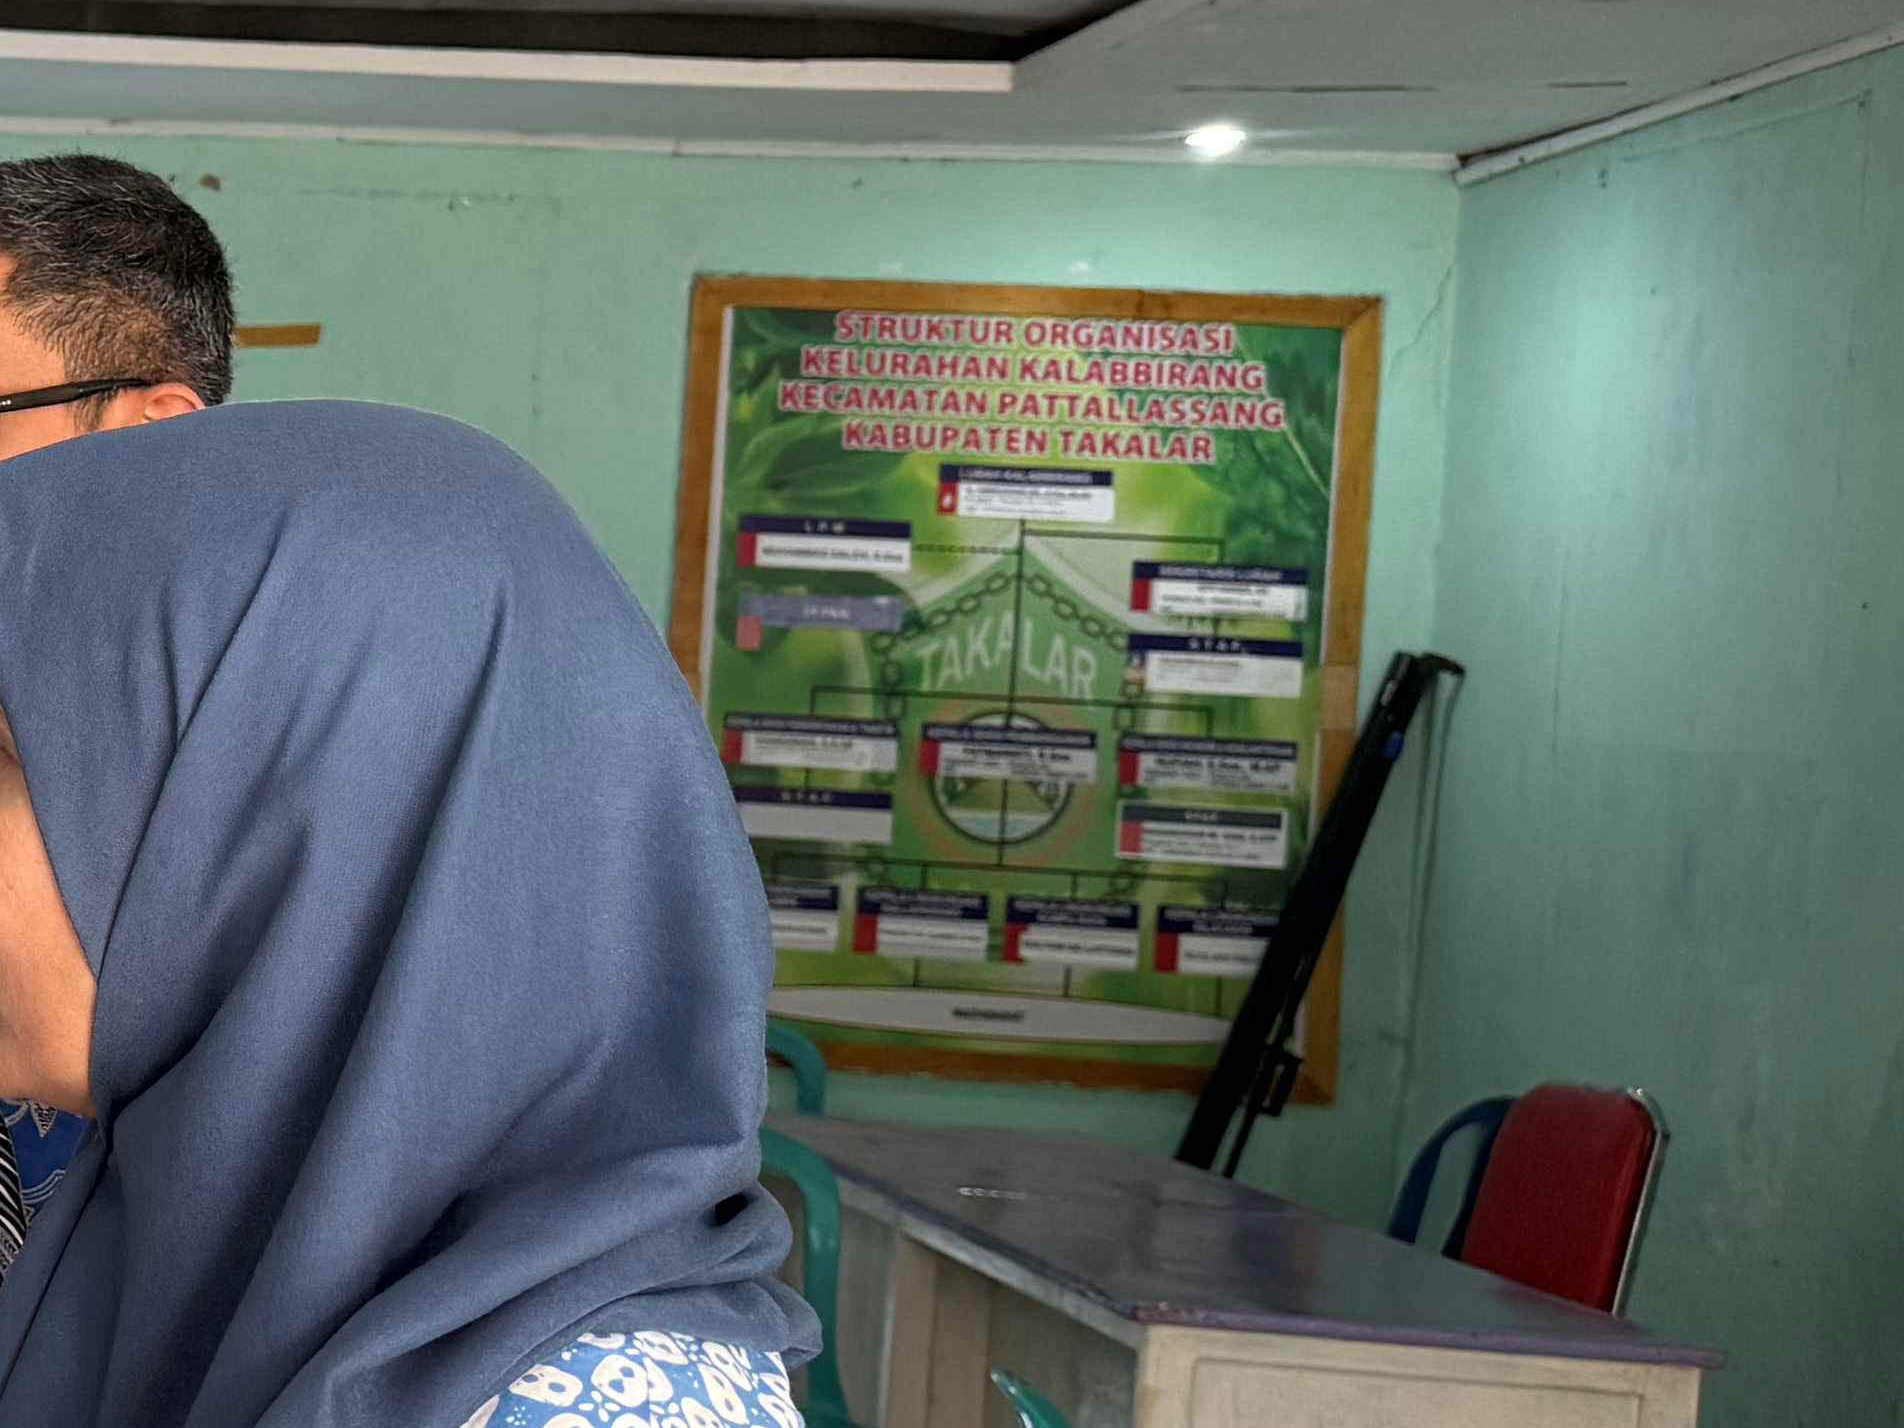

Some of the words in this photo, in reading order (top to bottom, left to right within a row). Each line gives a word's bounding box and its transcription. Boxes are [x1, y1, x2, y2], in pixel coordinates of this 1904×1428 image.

[835, 312, 1015, 345] STRUKTUR
[1023, 319, 1234, 354] ORGANISASI
[801, 346, 1009, 380] KELURAHAN
[1018, 353, 1264, 391] KALABBIRANG
[778, 382, 988, 415] KECAMATAN
[997, 388, 1284, 429] PATTALLASSANG
[843, 419, 1047, 455] KABUPATEN
[1057, 427, 1214, 463] TAKALAR
